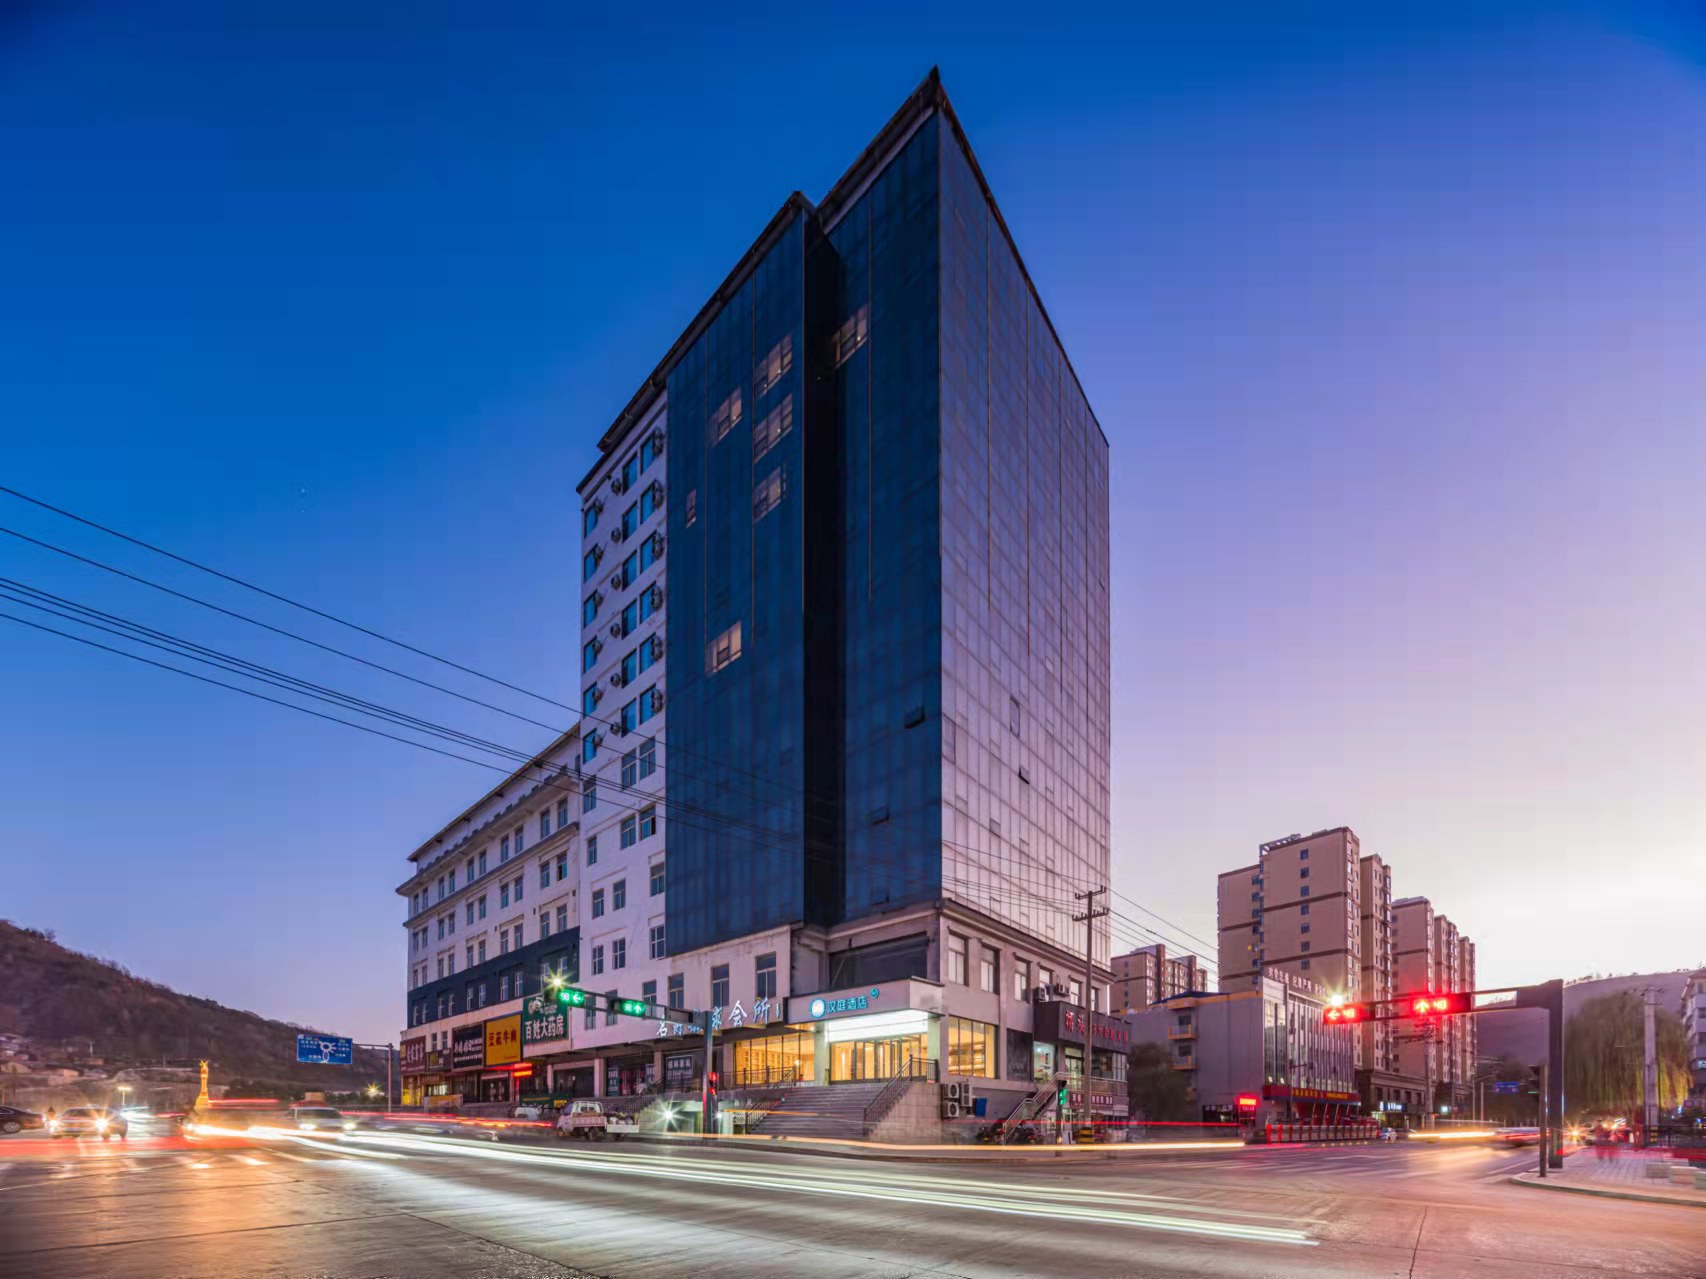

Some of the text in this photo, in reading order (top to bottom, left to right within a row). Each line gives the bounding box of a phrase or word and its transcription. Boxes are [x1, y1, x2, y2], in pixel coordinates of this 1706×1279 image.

[827, 996, 868, 1013] 汉庭酒店
[525, 1015, 564, 1040] 百姓大药房
